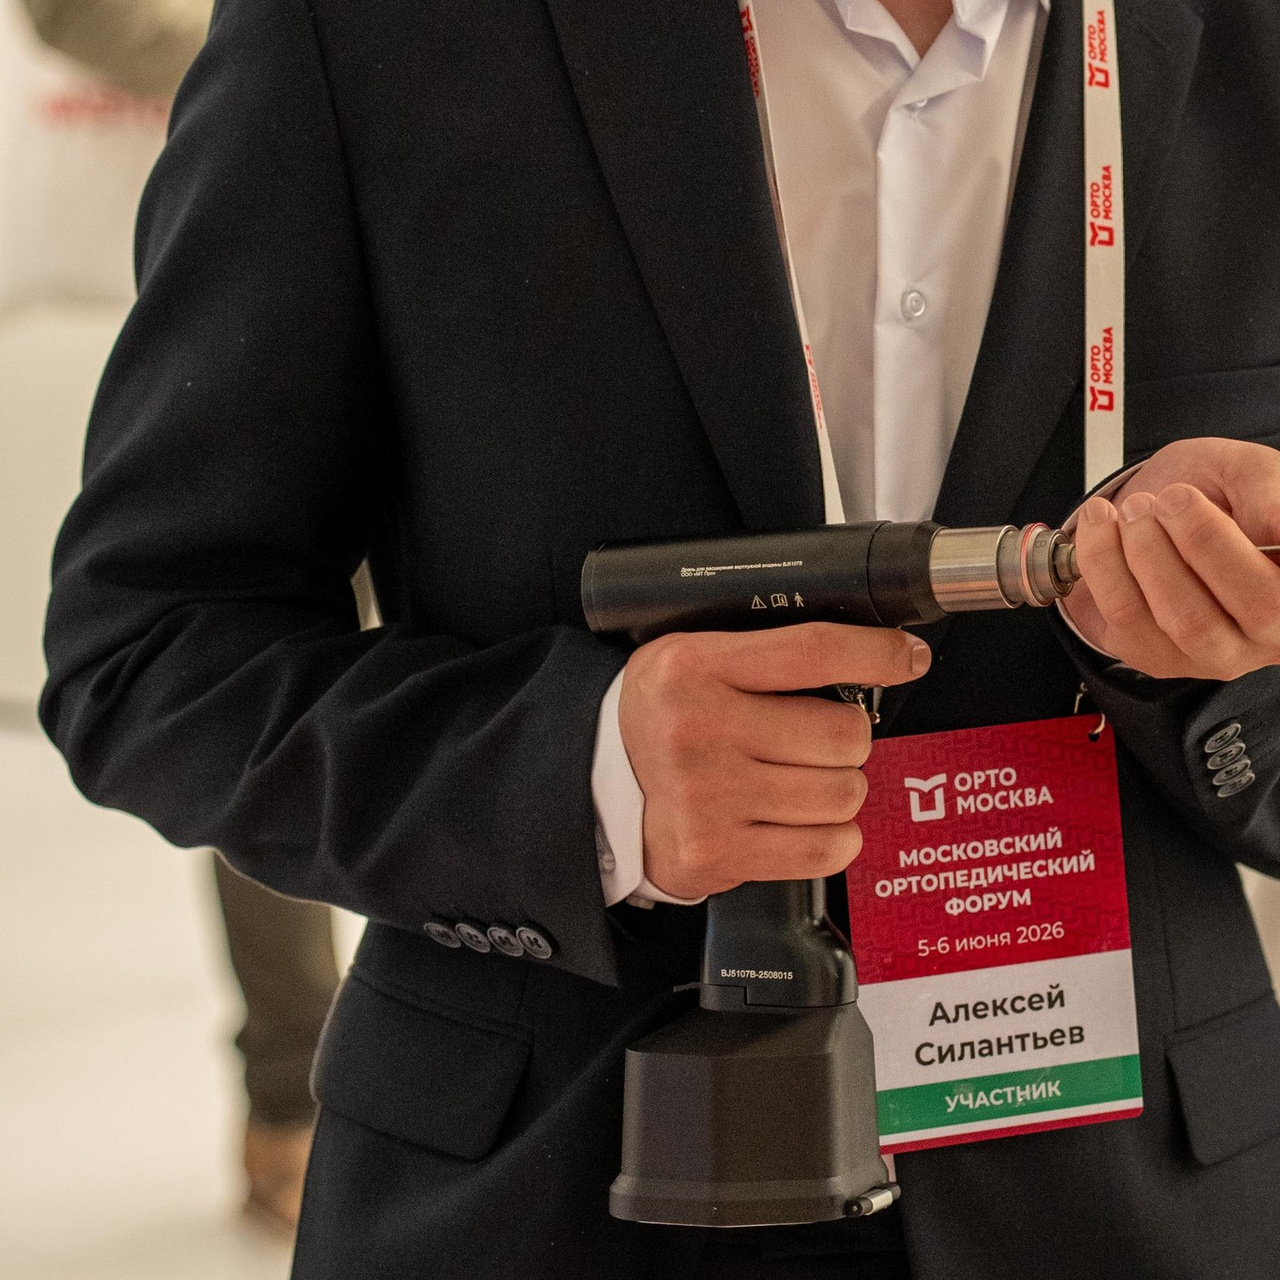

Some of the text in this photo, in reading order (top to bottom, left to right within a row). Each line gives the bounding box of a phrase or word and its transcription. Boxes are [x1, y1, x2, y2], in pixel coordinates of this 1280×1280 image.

[1088, 24, 1097, 60] ОРТО
[1097, 10, 1107, 63] МОСКВА
[1090, 182, 1101, 219] ОРТО
[1102, 165, 1113, 220] МОСКВА
[1091, 345, 1102, 383] ОРТО
[1103, 326, 1114, 385] МОСКВА
[954, 767, 1017, 792] ОРТО
[956, 785, 1054, 815] МОСКВА
[899, 826, 1063, 868] МОСКОВСКИЙ
[874, 849, 1096, 898] ОРТОПЕДИЧЕСКИЙ
[944, 888, 1032, 916] ФОРУМ
[917, 921, 1066, 957] 5-6 июня 2026
[721, 969, 793, 979] BJ5107B-2508015
[928, 983, 1066, 1027] Алексей
[914, 1024, 1086, 1066] Силантьев
[944, 1079, 1061, 1113] УЧАСТНИК
